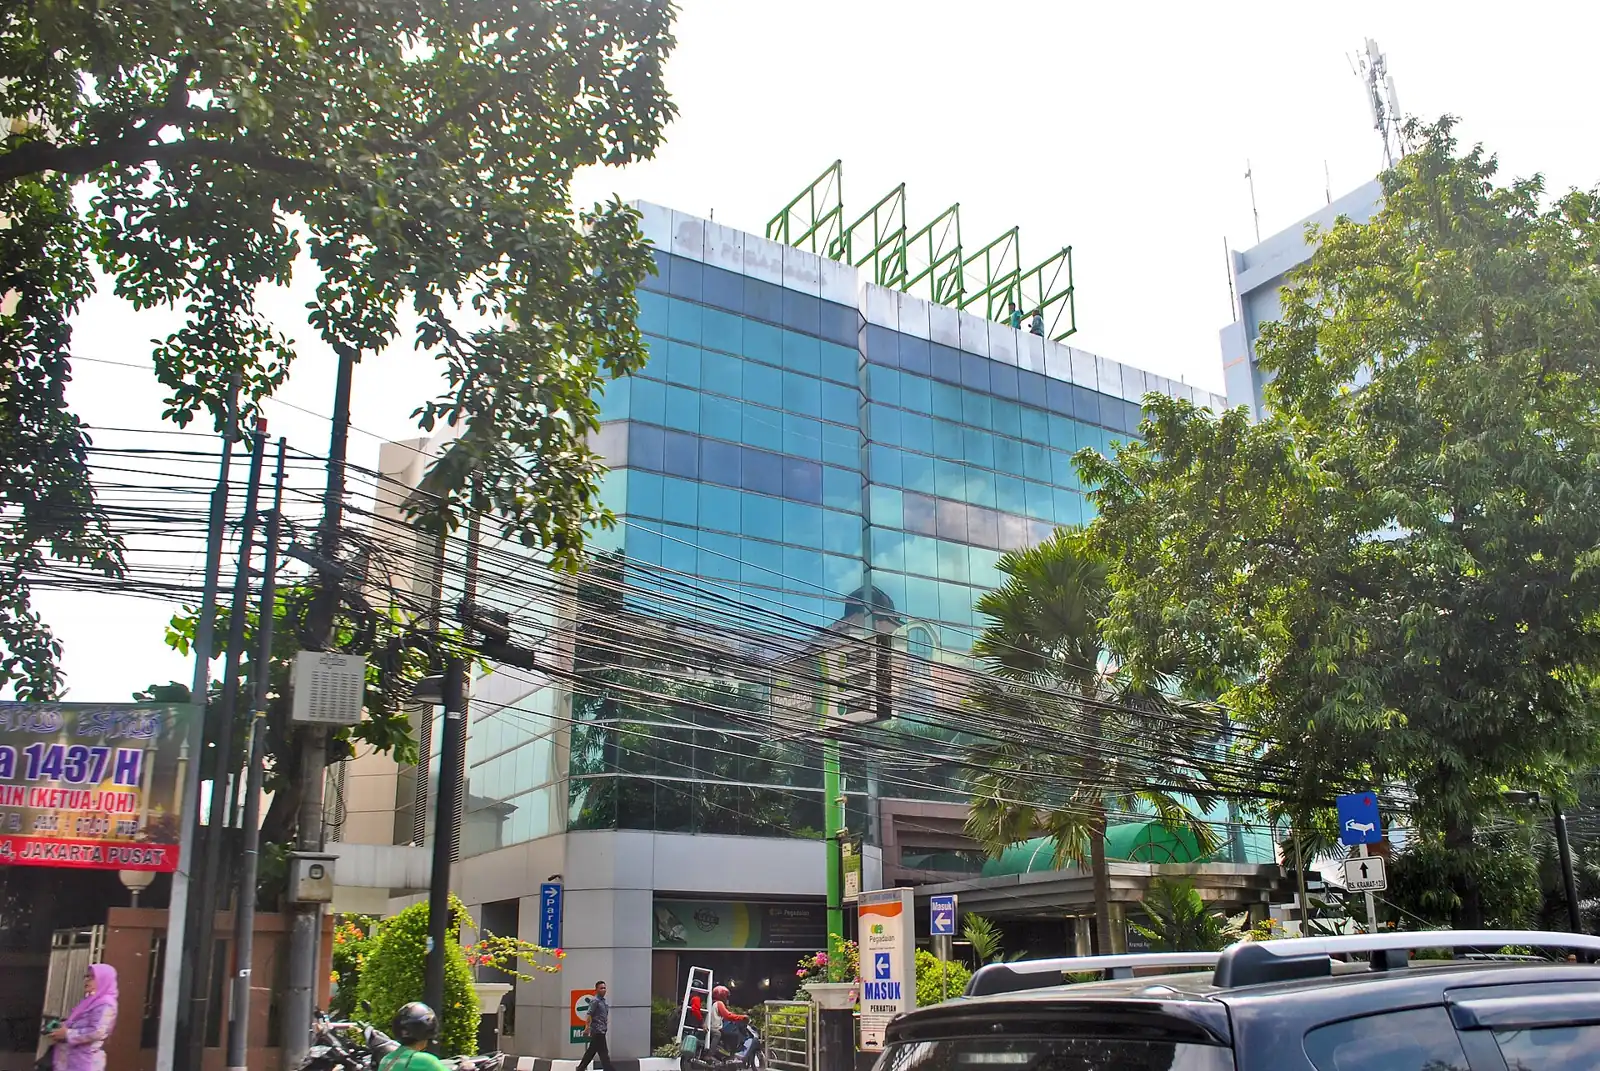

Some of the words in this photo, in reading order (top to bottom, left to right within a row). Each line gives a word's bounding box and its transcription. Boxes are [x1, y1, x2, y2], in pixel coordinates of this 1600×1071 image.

[24, 741, 111, 784] 1437
[112, 748, 143, 787] H
[20, 841, 105, 863] JAKARTA
[107, 845, 166, 865] PUSAT
[932, 901, 952, 911] Masuk
[546, 898, 555, 946] Parkir
[864, 981, 901, 1000] MASUK
[870, 1004, 897, 1013] PERHATIAN
